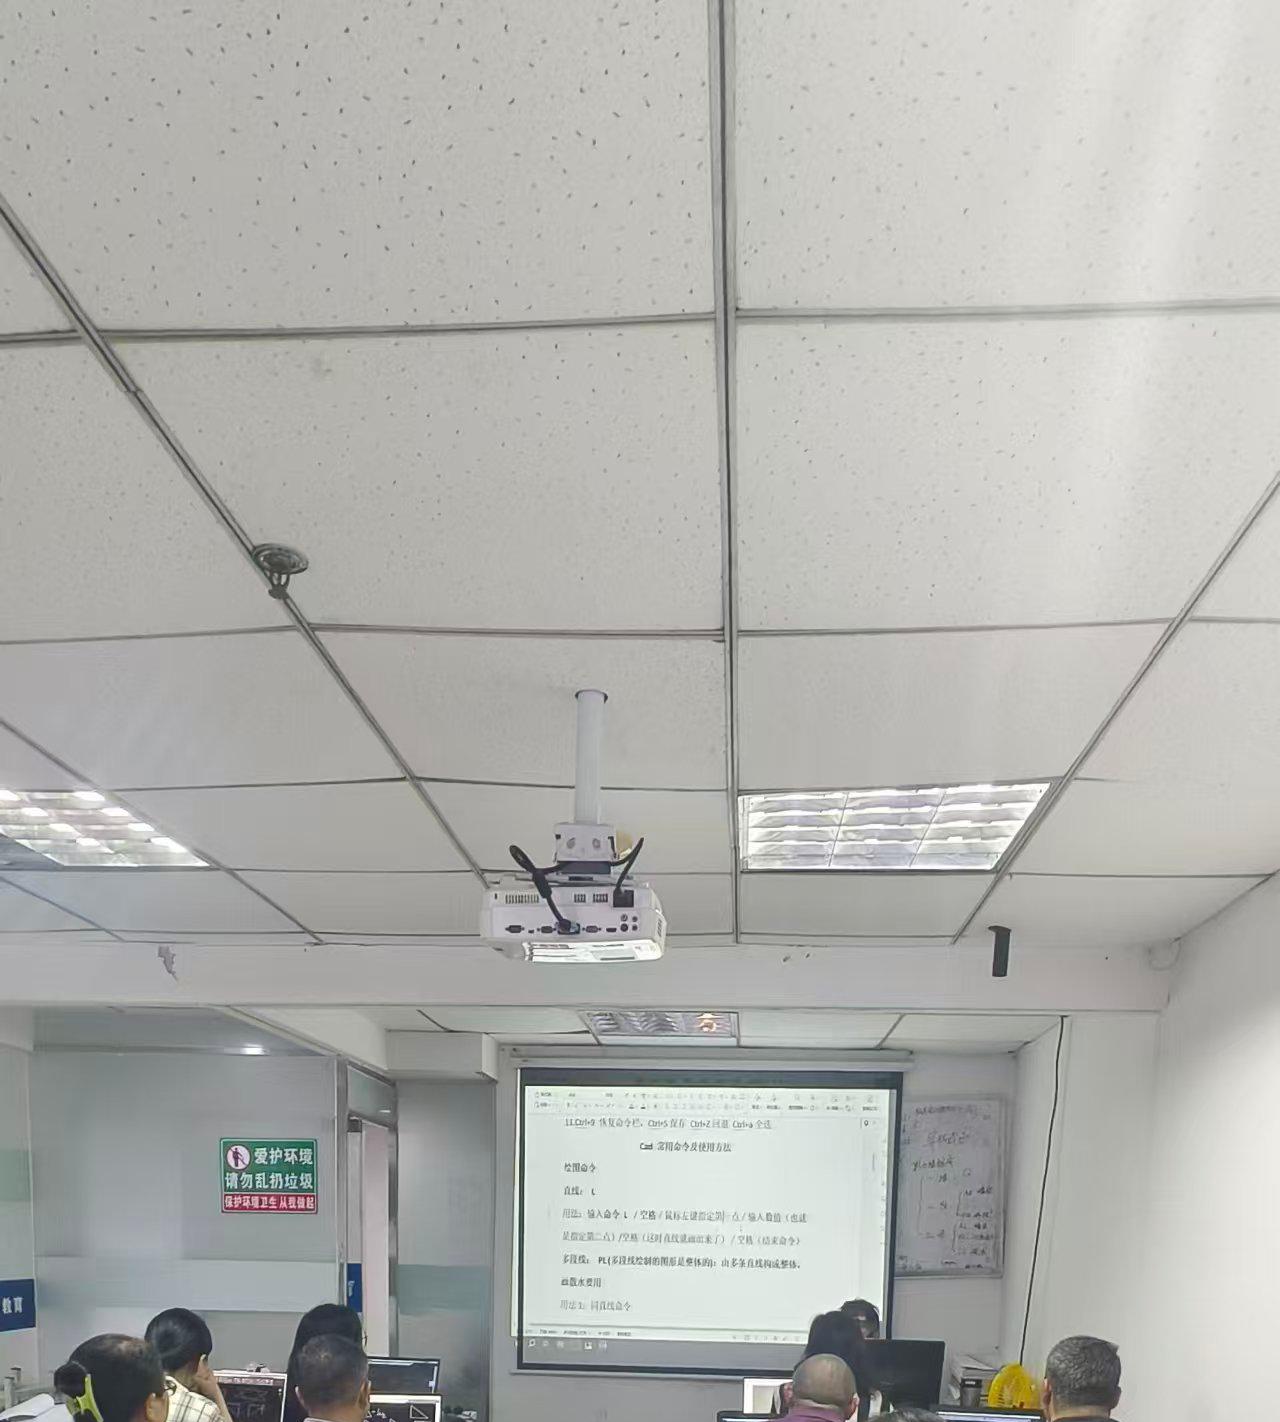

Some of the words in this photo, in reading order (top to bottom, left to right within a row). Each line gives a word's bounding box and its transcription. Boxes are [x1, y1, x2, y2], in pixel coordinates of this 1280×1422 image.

[253, 1147, 314, 1165] 爱护环境
[563, 1162, 596, 1173] 绘图命令
[224, 1172, 314, 1190] 请勿乱扔垃圾
[224, 1195, 278, 1209] 保护环境卫生
[279, 1196, 315, 1209] 从我做起
